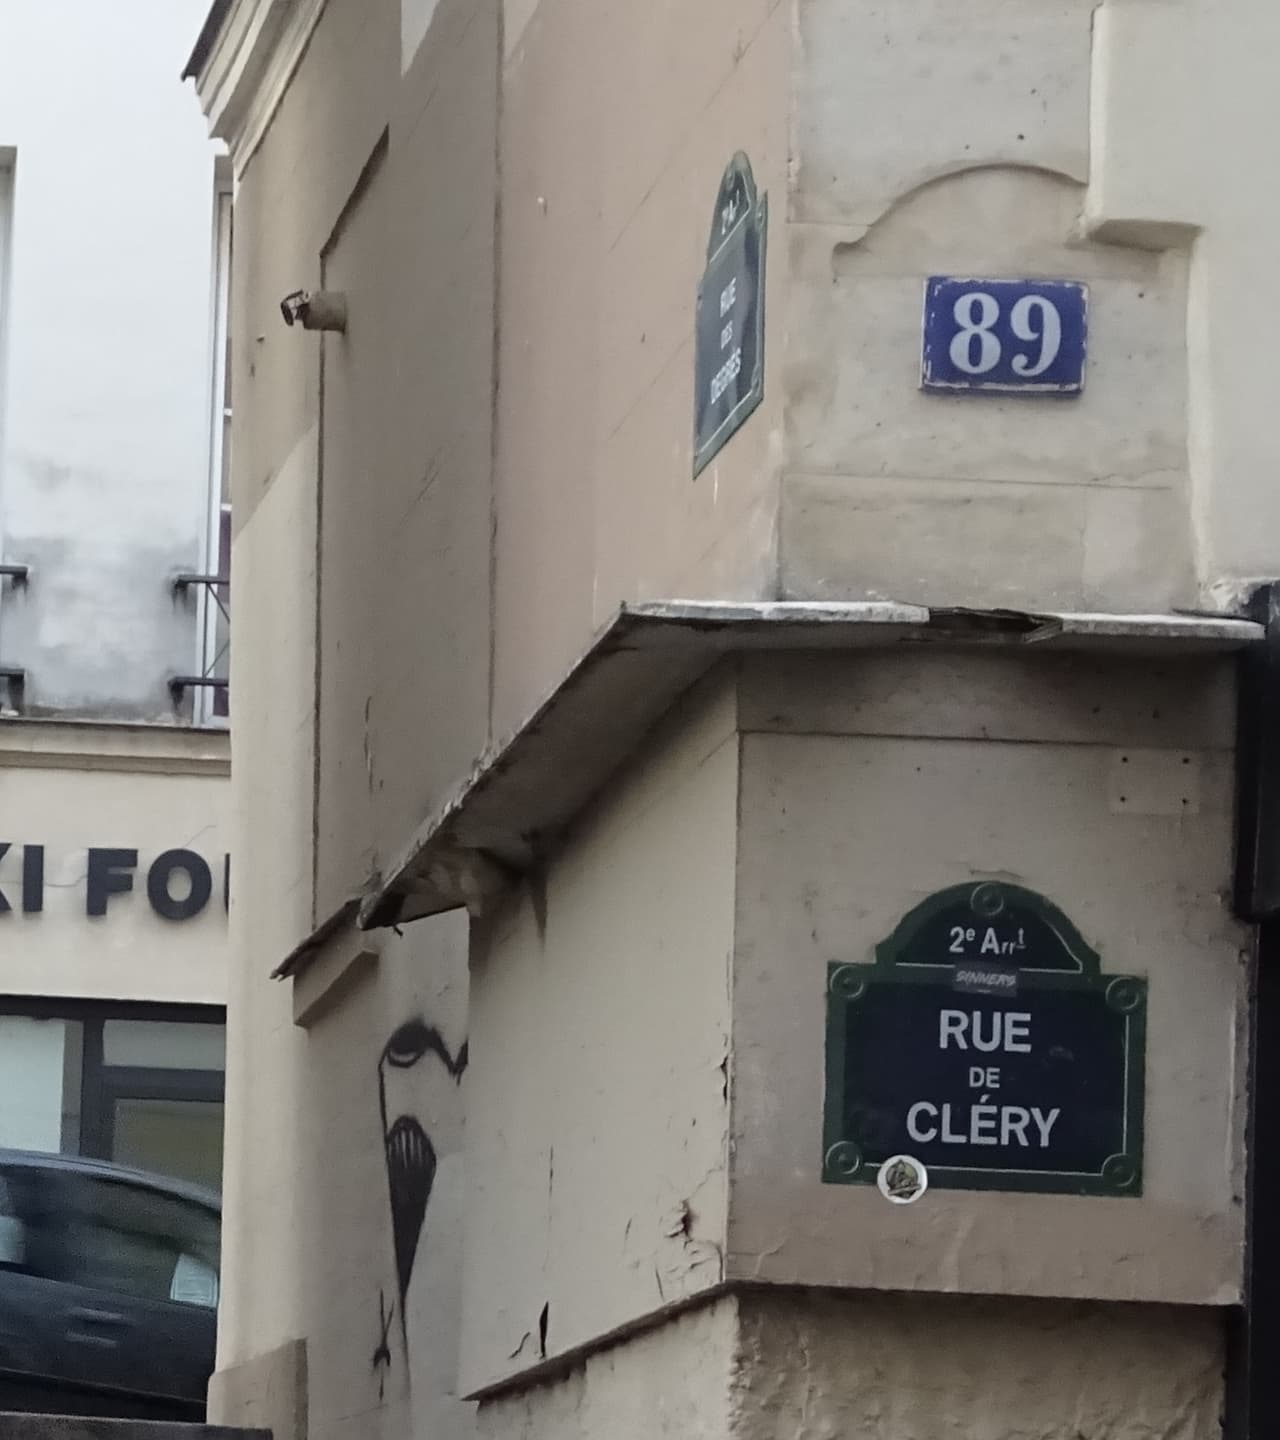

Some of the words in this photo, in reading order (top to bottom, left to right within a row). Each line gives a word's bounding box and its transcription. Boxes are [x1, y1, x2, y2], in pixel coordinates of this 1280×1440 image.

[949, 292, 1062, 376] 89
[86, 847, 231, 921] FO
[939, 1009, 1032, 1053] RUE
[968, 1066, 1001, 1089] DE
[906, 1094, 1061, 1147] CLÉRY
